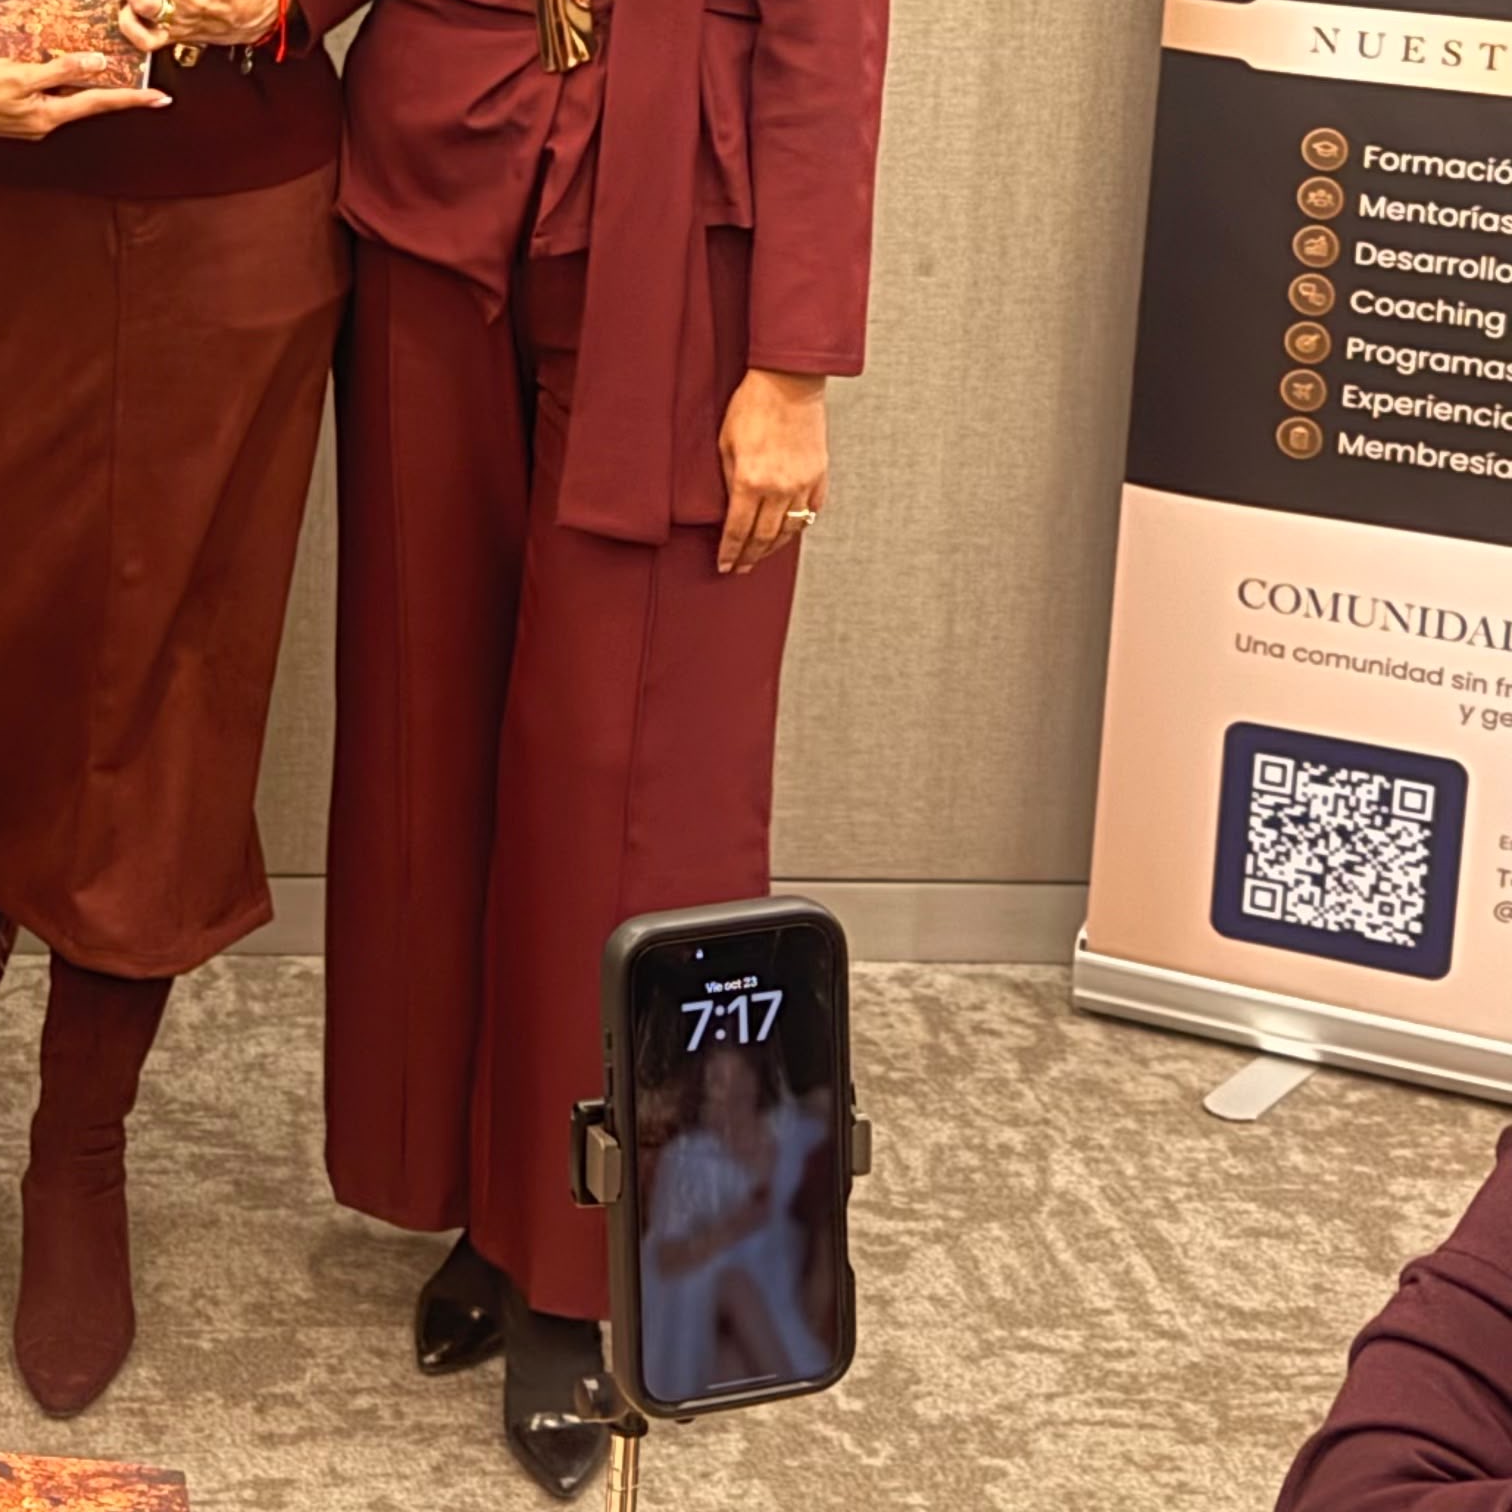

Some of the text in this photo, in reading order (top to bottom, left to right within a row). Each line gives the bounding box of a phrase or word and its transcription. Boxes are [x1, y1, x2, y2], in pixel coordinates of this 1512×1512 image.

[1309, 26, 1507, 71] NUEST
[1363, 144, 1512, 185] Formació
[1354, 241, 1512, 284] Desarrollo
[1349, 290, 1507, 339] Coaching
[1338, 432, 1512, 479] Membresía
[1237, 577, 1512, 653] COMUNIDA
[1235, 633, 1286, 659] Una
[1292, 646, 1444, 687] comunidad
[1451, 671, 1488, 694] sin
[1459, 704, 1475, 726] y
[705, 976, 758, 994] Vie oct 23
[681, 990, 783, 1051] 7:17
